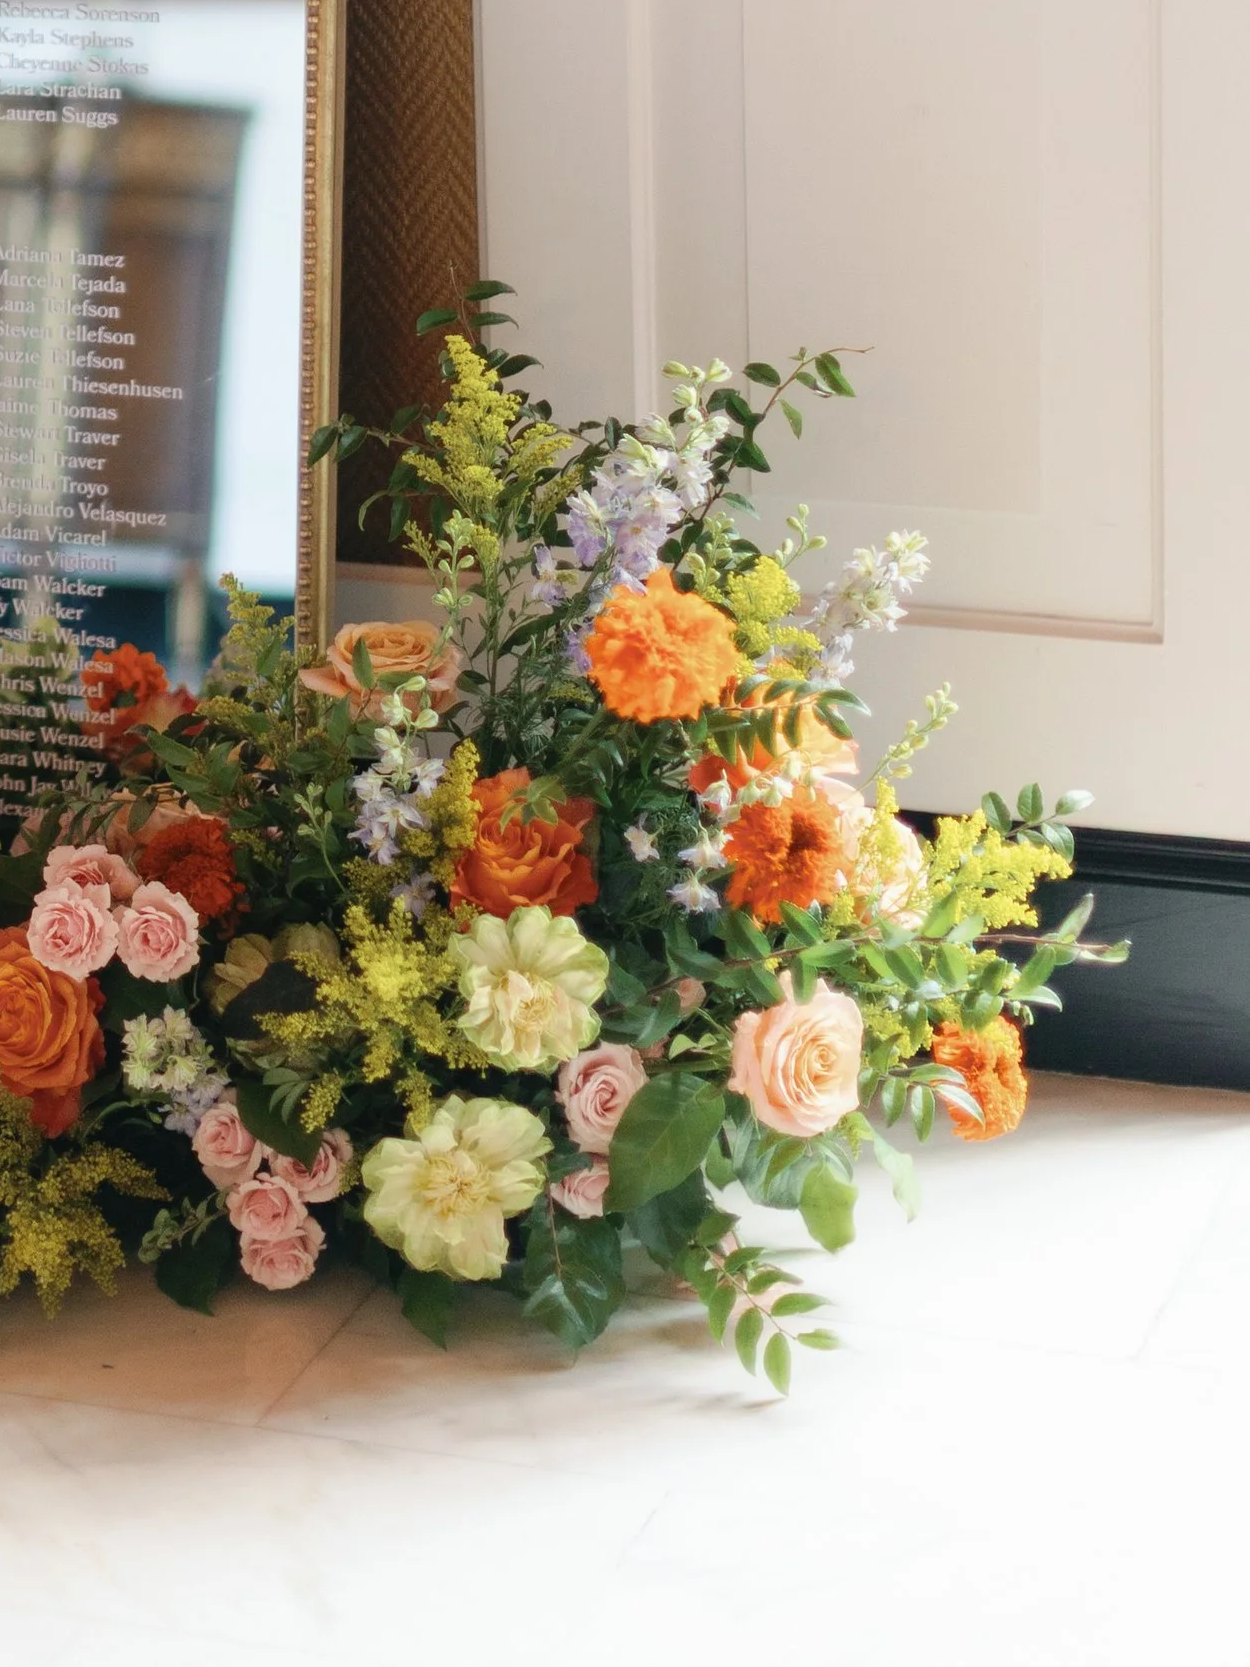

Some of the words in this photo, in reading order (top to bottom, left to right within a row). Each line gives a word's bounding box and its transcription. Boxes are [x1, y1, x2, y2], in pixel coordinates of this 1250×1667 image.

[51, 28, 133, 51] Stephens
[62, 106, 118, 128] Suggs
[79, 502, 166, 530] Velasquez
[46, 525, 106, 547] Vicarel
[33, 575, 105, 598] Walcker
[54, 627, 117, 649] Walesa
[39, 676, 104, 699] Wenzel
[32, 752, 105, 777] Whitney
